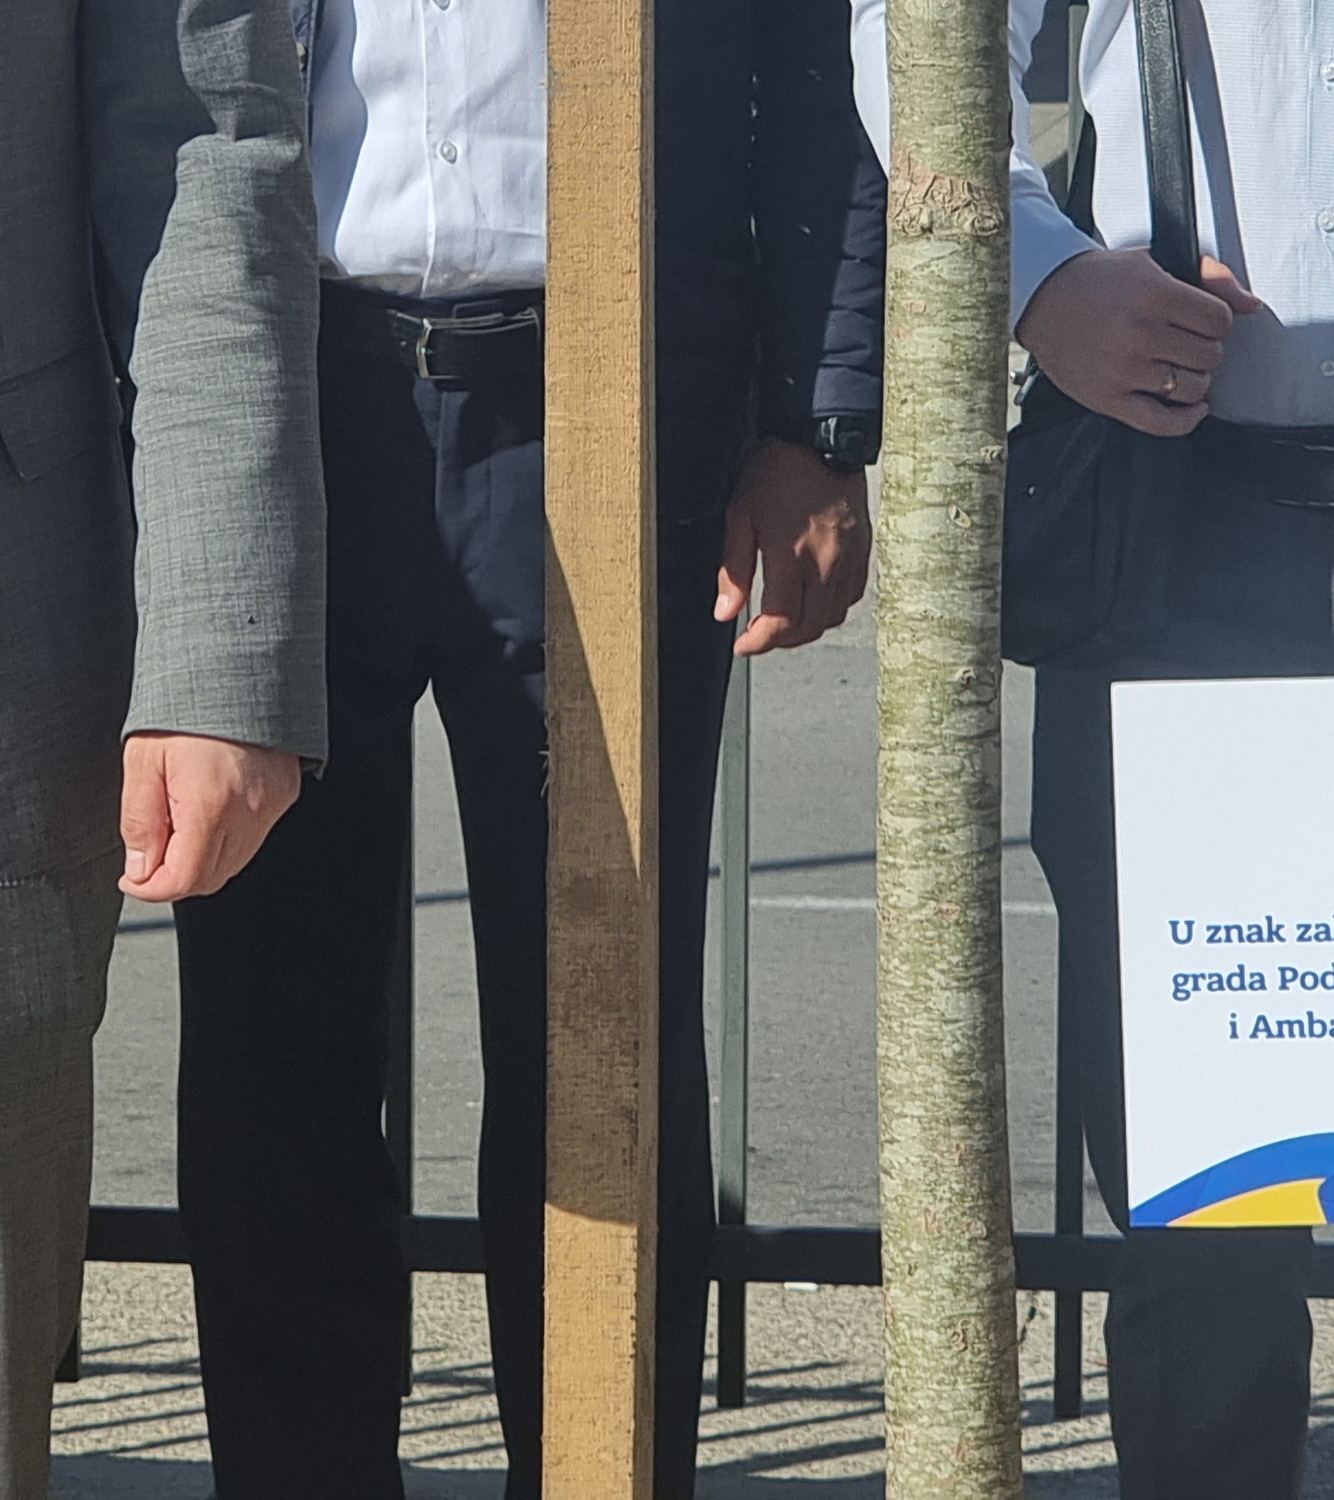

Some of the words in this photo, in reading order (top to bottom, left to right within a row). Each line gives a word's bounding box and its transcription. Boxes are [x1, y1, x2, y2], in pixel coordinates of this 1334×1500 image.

[1168, 919, 1196, 945] U
[1205, 915, 1287, 944] znak
[1171, 963, 1268, 1002] grada
[1228, 1012, 1239, 1040] i
